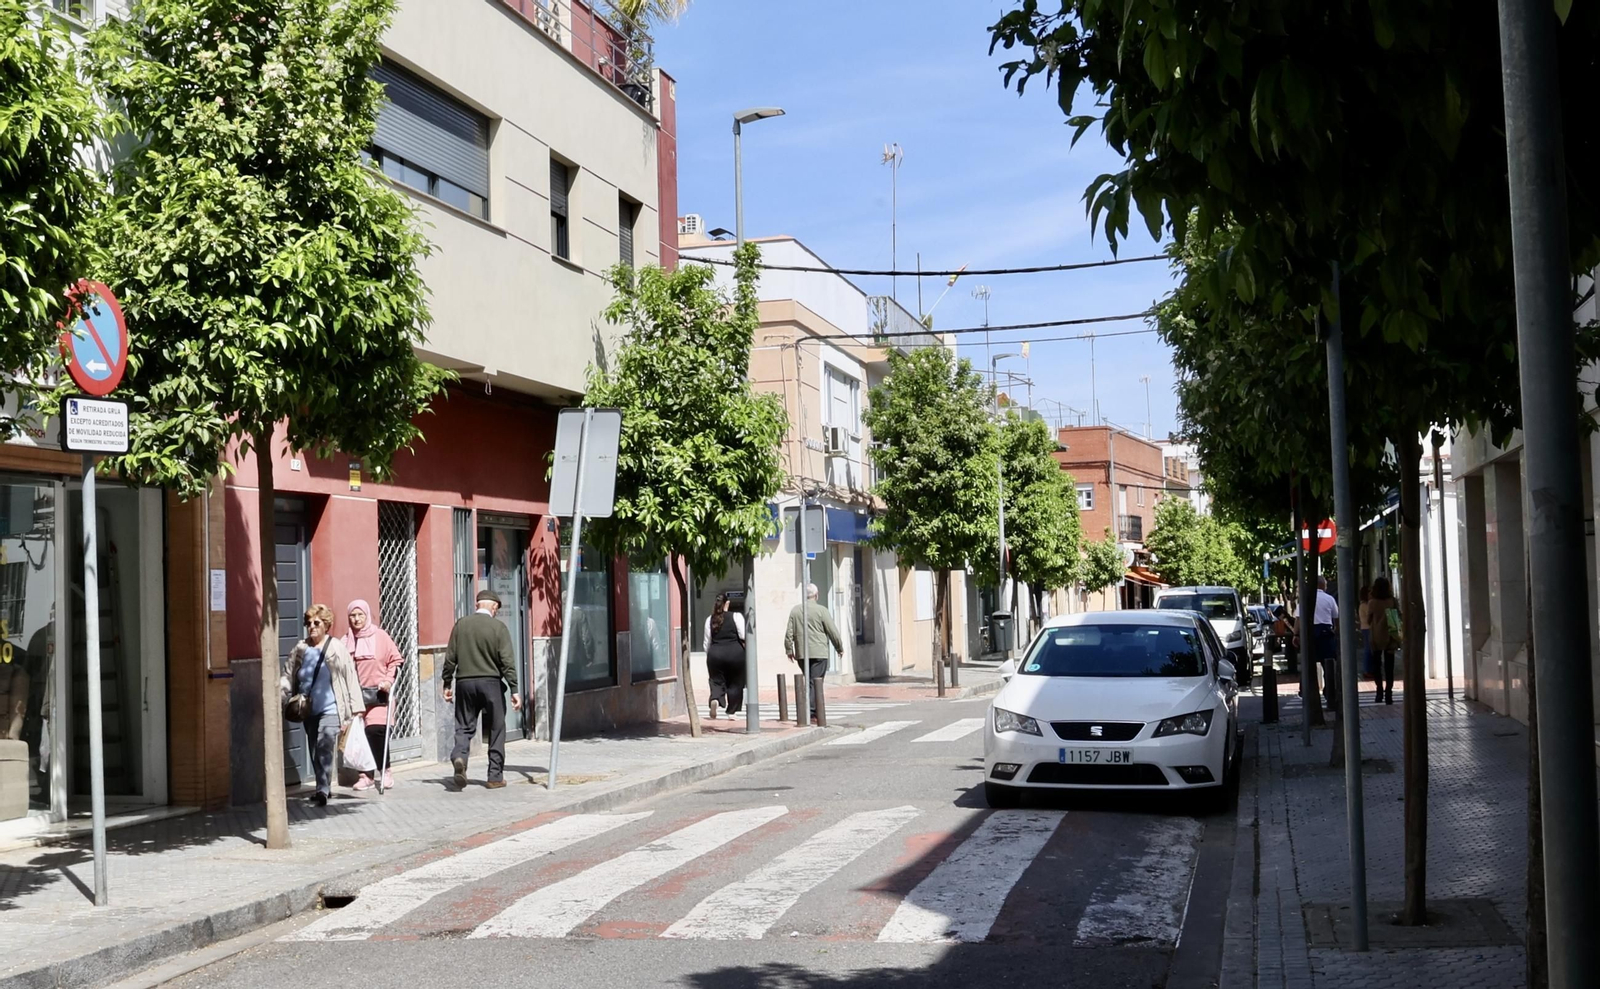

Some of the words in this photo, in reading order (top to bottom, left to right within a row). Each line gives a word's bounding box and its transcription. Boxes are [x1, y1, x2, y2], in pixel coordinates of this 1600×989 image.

[83, 405, 107, 414] RETIRADA
[70, 418, 92, 426] EXCEPTO
[93, 419, 124, 428] ACREDITADOS
[69, 427, 75, 435] DE
[76, 428, 103, 437] MOVILIDAD
[103, 430, 127, 438] REDUCIDA
[1070, 750, 1100, 763] 1157
[1105, 750, 1131, 763] JBW
